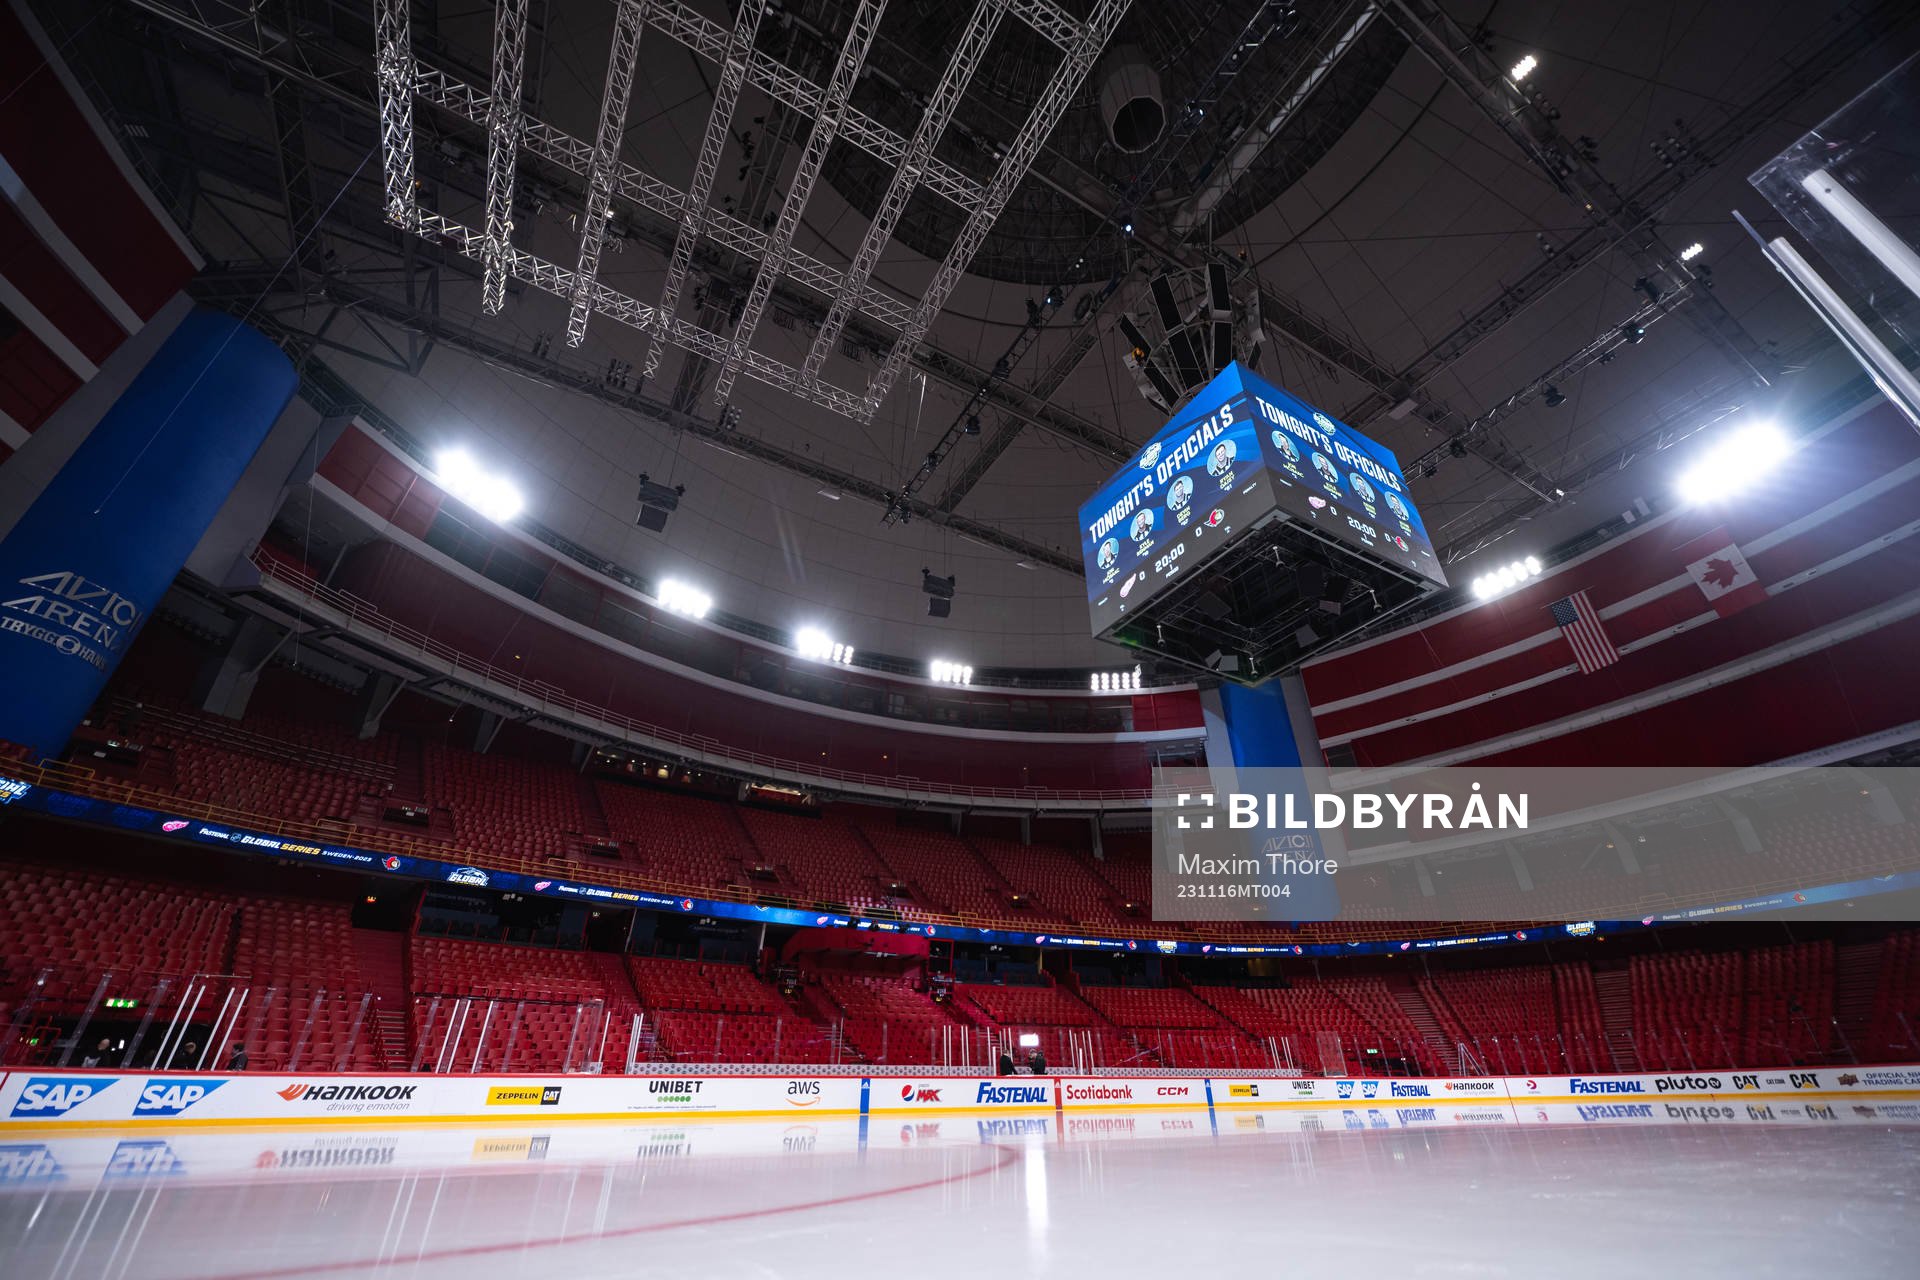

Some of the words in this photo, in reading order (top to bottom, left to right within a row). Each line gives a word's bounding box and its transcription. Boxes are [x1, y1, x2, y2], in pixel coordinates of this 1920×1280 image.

[1255, 396, 1334, 455] TONIGHT'S
[1334, 441, 1402, 492] OFFICIALS
[1089, 474, 1154, 544] TONIGHT'S
[1156, 404, 1234, 485] OFFICIALS
[1195, 527, 1202, 537] 0
[1347, 515, 1377, 538] 20:00
[1155, 542, 1185, 573] 20:00
[1139, 571, 1145, 581] 0
[1, 595, 119, 651] AREN
[240, 836, 281, 849] GLOBAL
[280, 843, 321, 855] SERIES
[648, 1080, 704, 1094] UNIBET
[787, 1081, 821, 1095] aws
[1291, 1081, 1315, 1090] UNIBET
[1570, 1078, 1646, 1093] FASTENAL
[1655, 1076, 1708, 1093] pluto
[1732, 1075, 1761, 1090] CAT
[1789, 1073, 1820, 1088] CAT
[496, 1092, 539, 1100] ZEPPELIN
[542, 1090, 561, 1102] CAT
[976, 1082, 1048, 1103] FASTENAL
[1066, 1084, 1133, 1100] Scotiabank
[1157, 1087, 1189, 1096] CCM
[1337, 1084, 1352, 1095] SAP
[1362, 1084, 1378, 1095] SAP
[1391, 1081, 1431, 1097] FASTENAL
[16, 1083, 93, 1111] SAP
[137, 1084, 205, 1110] SAP
[326, 1102, 365, 1113] driving
[366, 1102, 410, 1111] emotion
